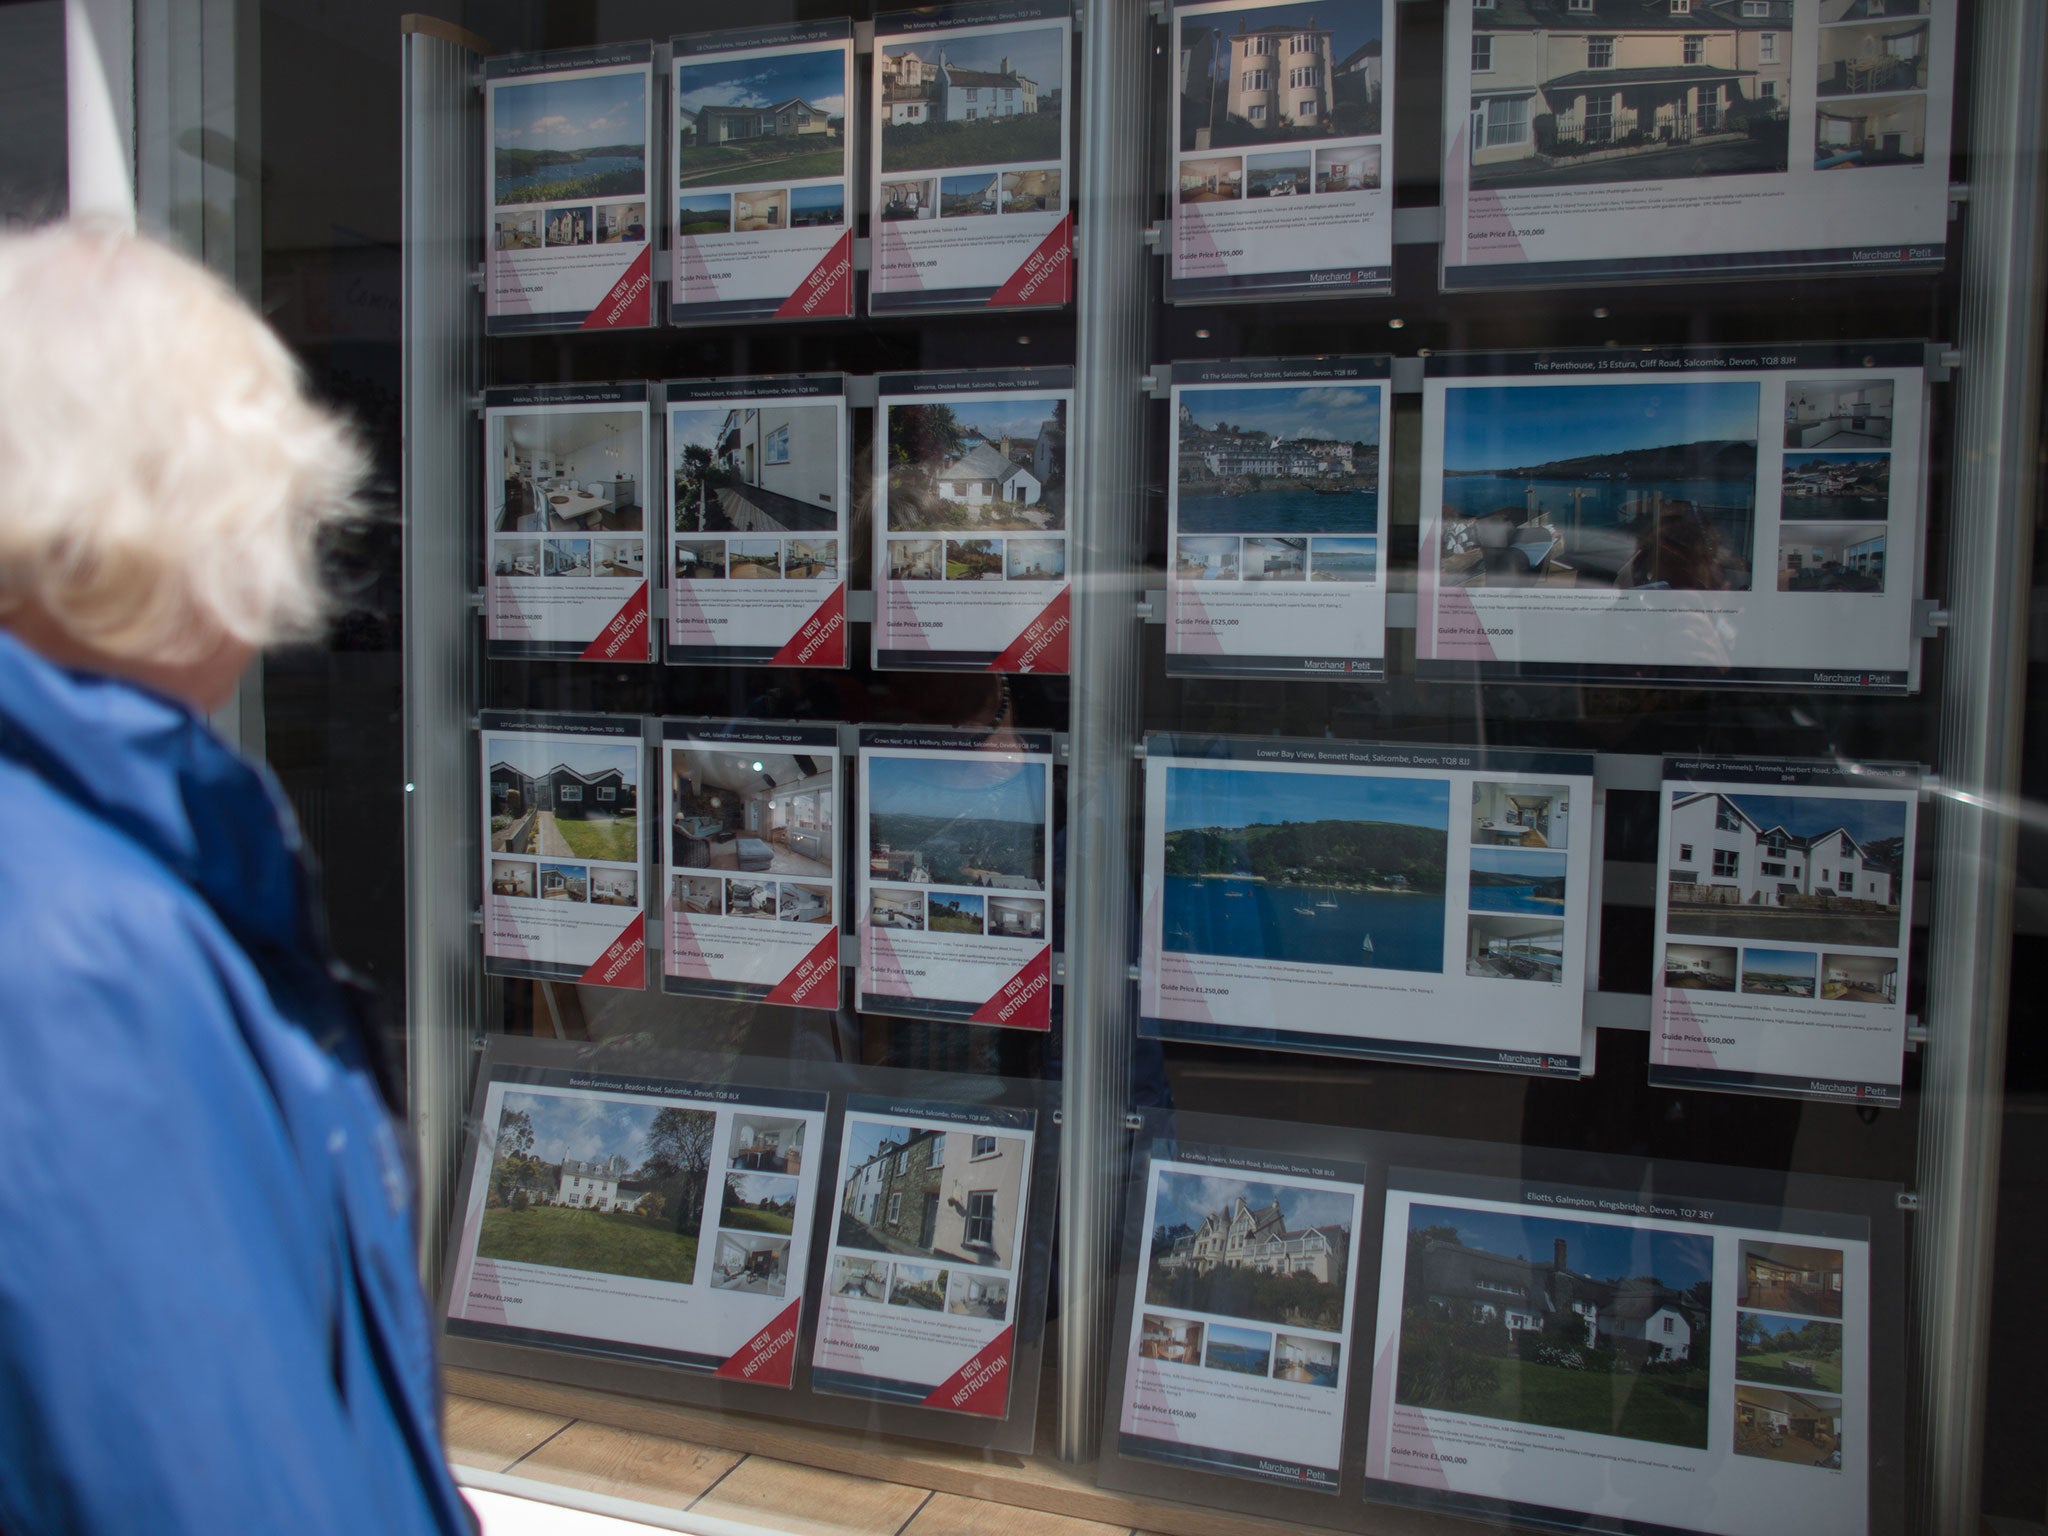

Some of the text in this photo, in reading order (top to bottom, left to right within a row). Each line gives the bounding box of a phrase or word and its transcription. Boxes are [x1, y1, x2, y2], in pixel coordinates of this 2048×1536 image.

[1508, 229, 1545, 238] £1,750,000
[1024, 252, 1044, 275] NEW
[1215, 250, 1244, 258] £795,000
[1852, 248, 1931, 260] Marchand Petit
[808, 266, 826, 288] NEW
[1018, 244, 1070, 301] INSTRUCTION
[1310, 270, 1376, 282] Marchand Petit
[612, 279, 629, 300] NEW
[802, 259, 850, 314] INSTRUCTION
[607, 274, 650, 326] INSTRUCTION
[1534, 362, 1547, 370] The
[1550, 361, 1595, 370] Penthouse,
[1610, 360, 1636, 369] Estura,
[1658, 359, 1682, 368] Road,
[1683, 358, 1726, 367] Salcombe,
[1729, 358, 1758, 366] Devon,
[1761, 357, 1779, 366] TQ8
[605, 609, 648, 658] INSTRUCTION
[610, 614, 626, 635] NEW
[802, 617, 820, 640] NEW
[1024, 621, 1044, 643] NEW
[1477, 628, 1513, 636] £1,500,000
[798, 612, 844, 664] INSTRUCTION
[1018, 615, 1070, 668] INSTRUCTION
[1304, 660, 1370, 669] Marchand Petit
[1814, 673, 1890, 683] Marchand Petit
[1257, 750, 1470, 766] Lower Bay View, Bennett Road, Salcombe, Devon, TQ8 8JJ
[603, 938, 644, 983] INSTRUCTION
[607, 942, 624, 960] NEW
[791, 955, 836, 1003] INSTRUCTION
[796, 959, 814, 980] NEW
[998, 973, 1049, 1022] INSTRUCTION
[1004, 976, 1024, 998] NEW
[1196, 987, 1229, 996] £1,250,000
[1703, 1036, 1735, 1046] £650,000
[1498, 1053, 1568, 1067] Marchand Petit
[570, 1078, 740, 1100] Beadon Farmhouse, Beadon Road, Salcombe, Devon, TQ8 8LX
[1810, 1081, 1886, 1096] Marchand Petit
[1527, 1193, 1714, 1219] Eliotts, Galmpton, Kingsbridge, Devon, TQ7 3EY
[751, 1331, 770, 1352] NEW
[823, 1338, 839, 1346] Guide
[840, 1340, 854, 1348] Price
[743, 1328, 794, 1377] INSTRUCTION
[961, 1358, 982, 1380] NEW
[952, 1355, 1007, 1406] INSTRUCTION
[1133, 1402, 1196, 1419] Guide Price £450,000
[1391, 1447, 1467, 1465] Guide Price £1,000,000
[1259, 1460, 1325, 1480] Marchand Petit
